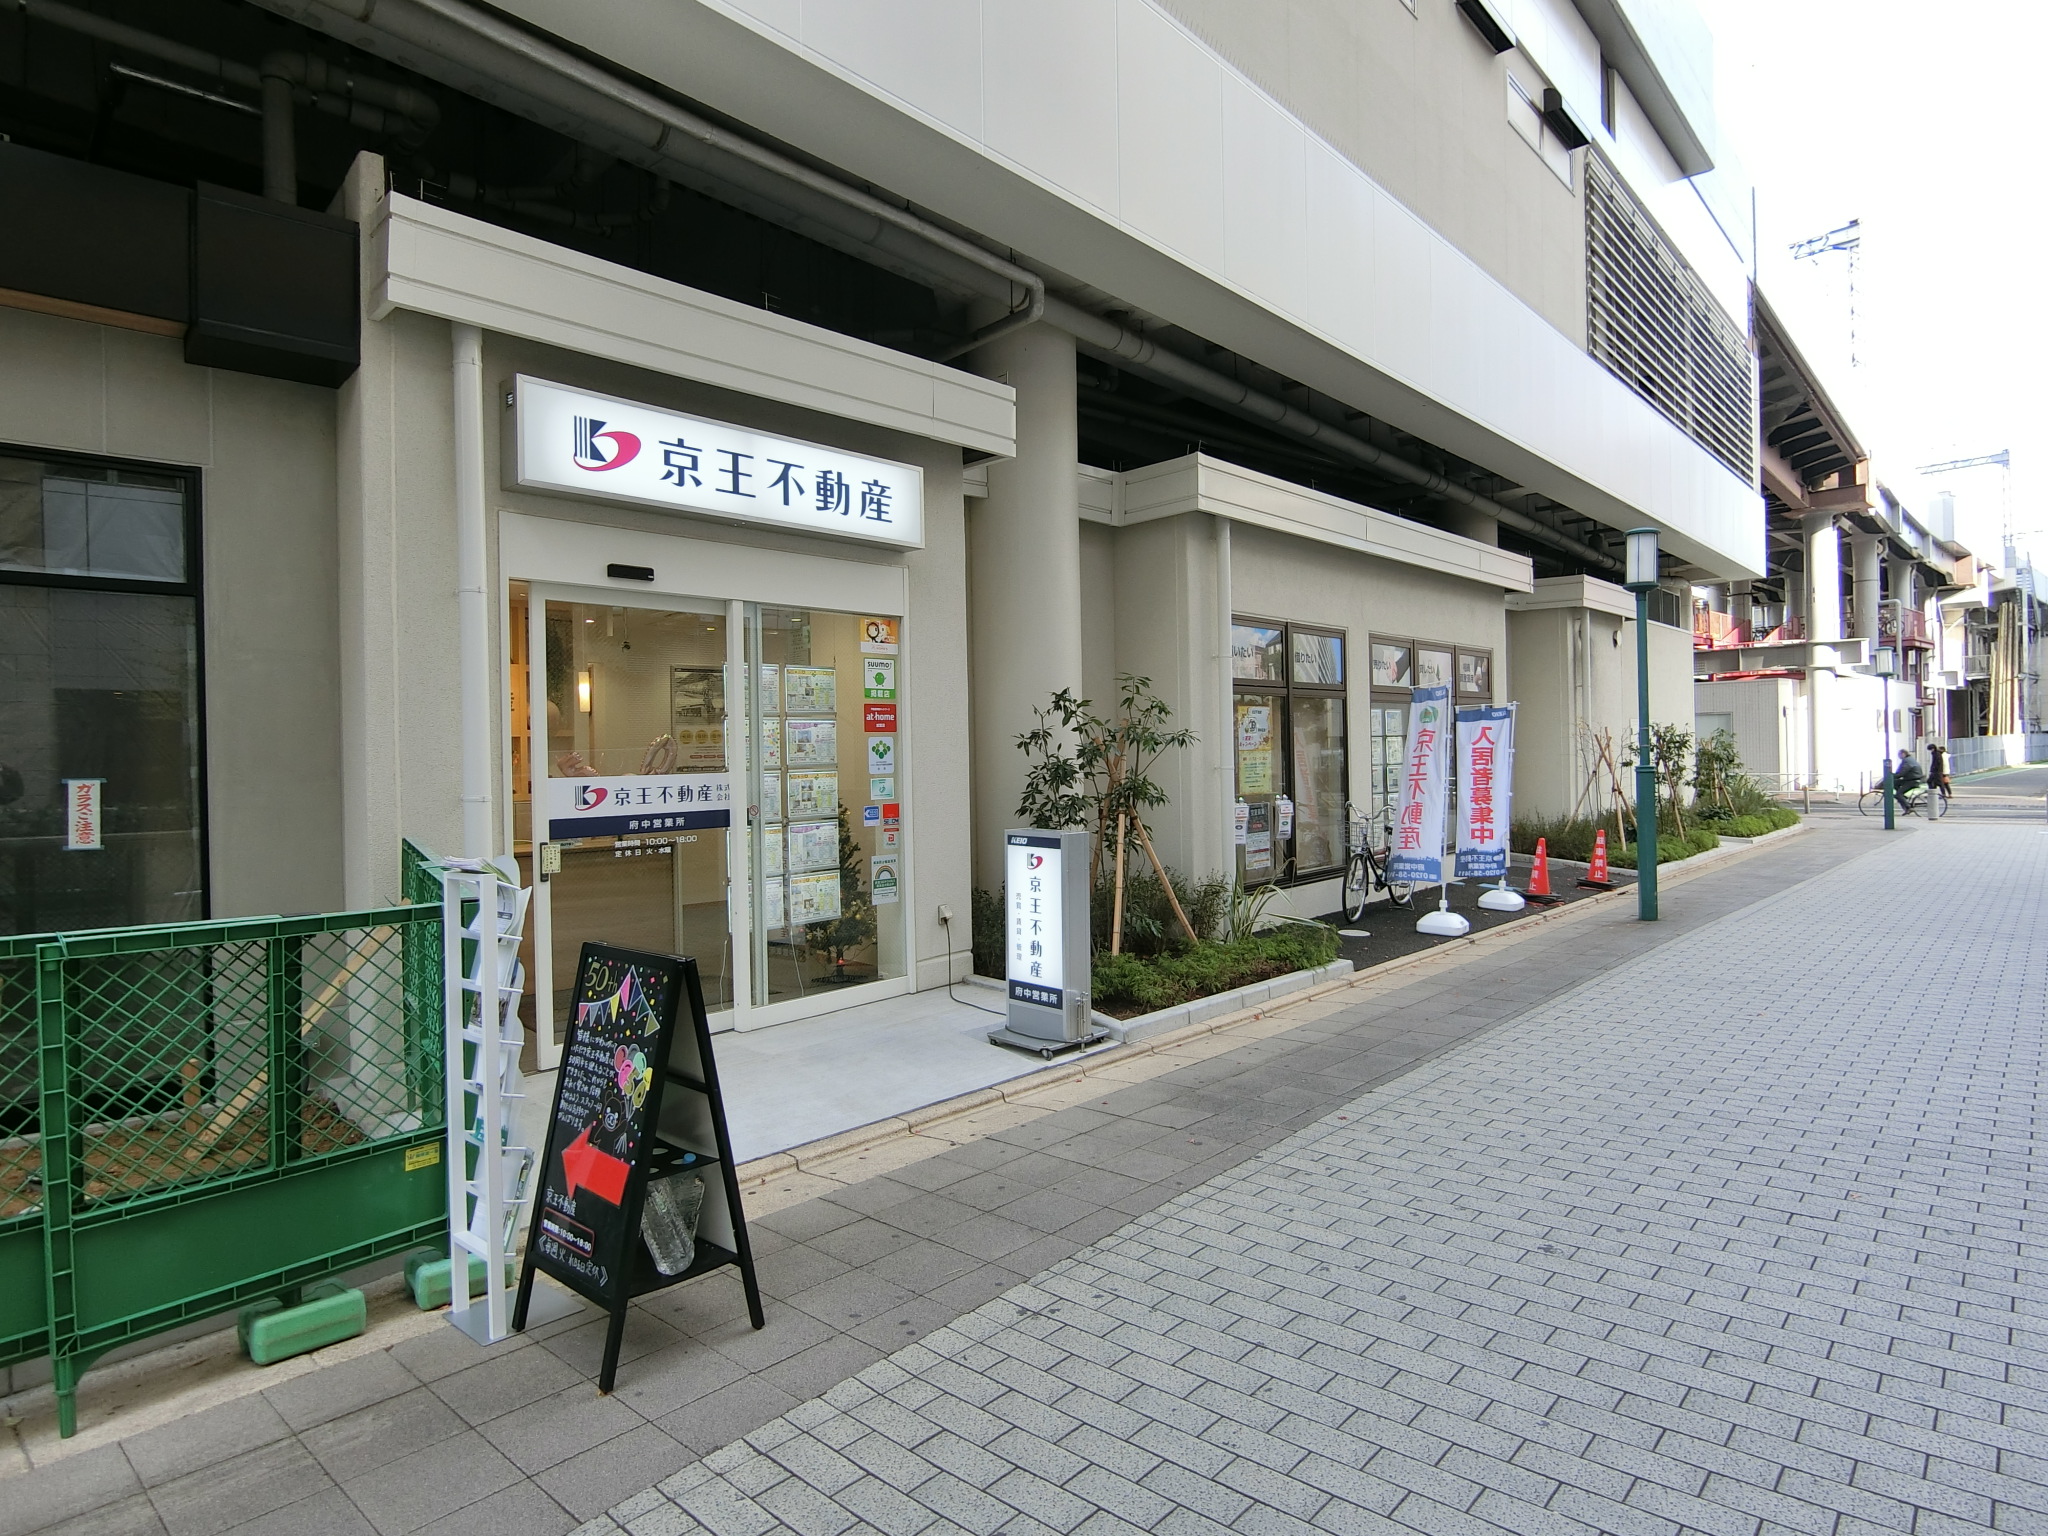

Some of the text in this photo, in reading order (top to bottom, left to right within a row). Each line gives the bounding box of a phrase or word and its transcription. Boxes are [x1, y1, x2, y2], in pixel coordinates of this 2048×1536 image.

[658, 438, 893, 523] 京王不動産
[1232, 645, 1254, 658] いたい
[614, 784, 712, 806] 京王不動産
[75, 784, 95, 844] ガラスご注意
[629, 817, 685, 830] 府中営業所
[614, 840, 640, 848] 営業時間
[1010, 836, 1028, 844] KEIO
[1030, 876, 1043, 978] 京王不動産
[585, 962, 618, 993] 50th
[1015, 986, 1058, 1004] 府中営業所
[546, 1185, 576, 1216] 京王不動産
